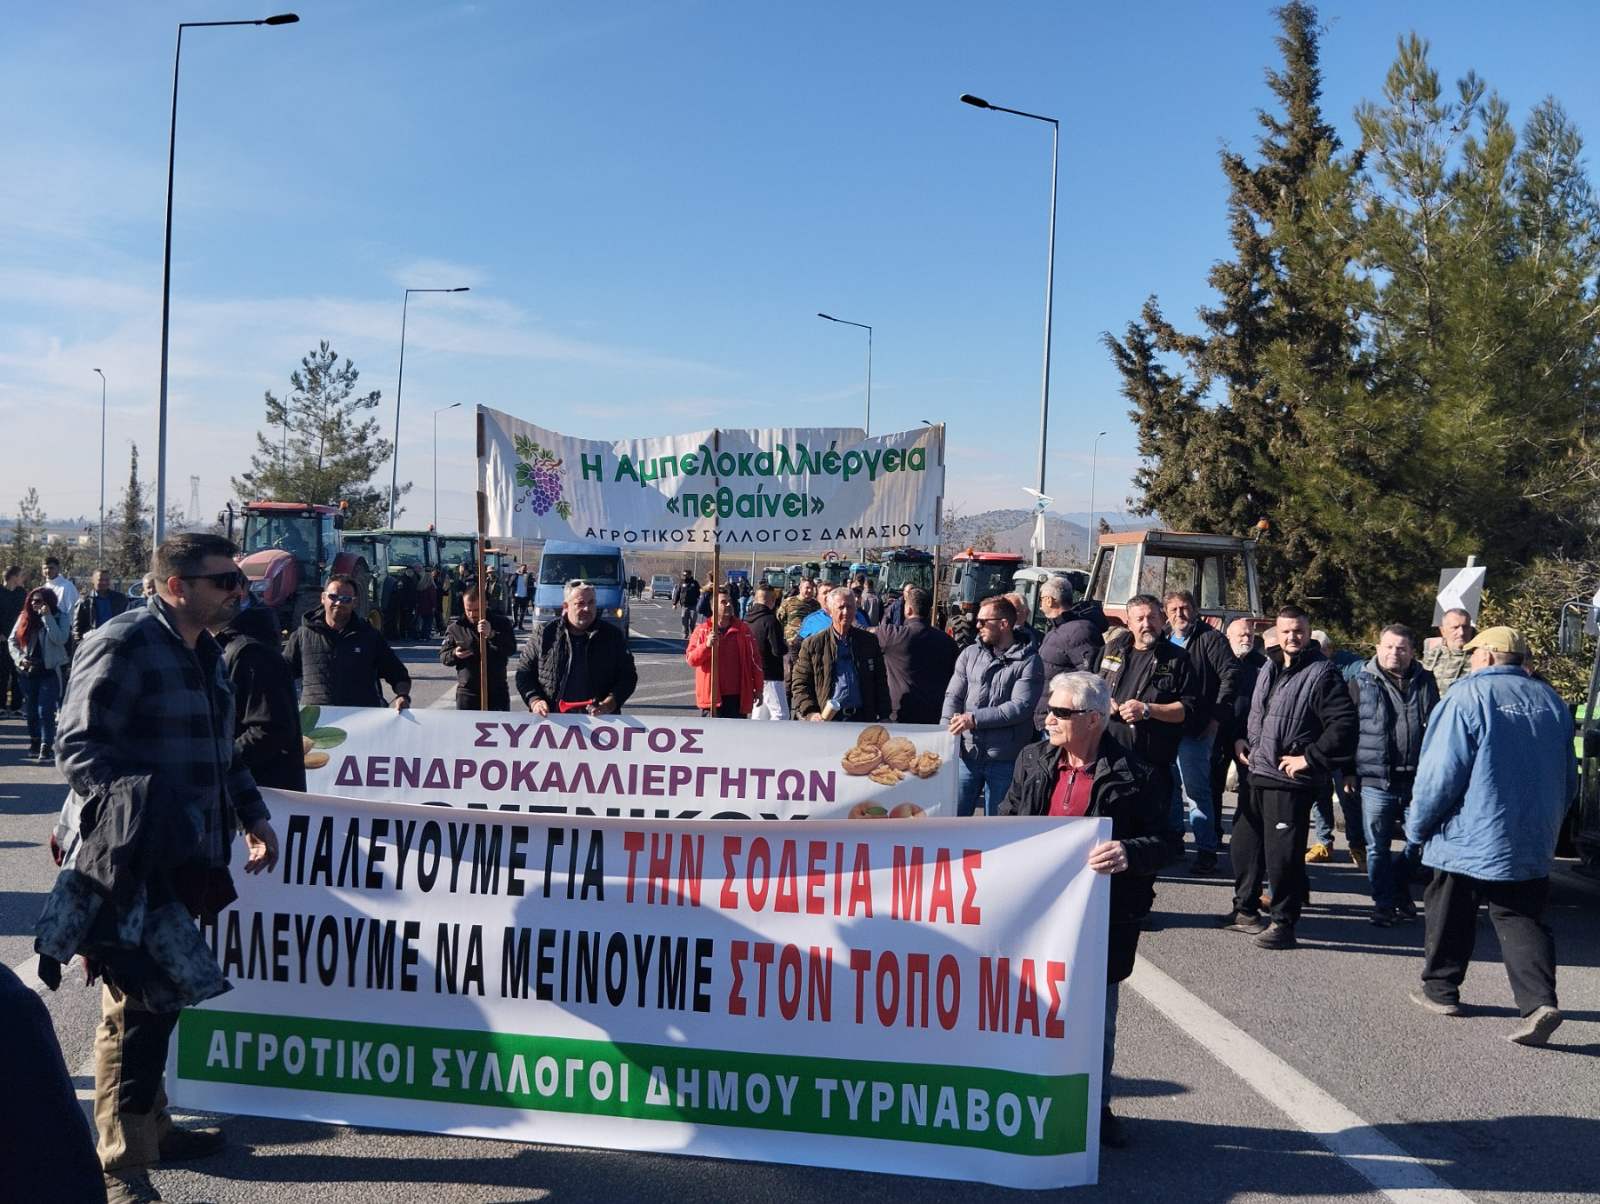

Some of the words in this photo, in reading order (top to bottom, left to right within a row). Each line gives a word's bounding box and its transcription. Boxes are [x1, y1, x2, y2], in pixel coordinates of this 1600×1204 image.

[580, 452, 604, 482] Η
[614, 440, 926, 488] Αμπελοκαλλιέργεια
[585, 526, 696, 543] ΑΓΡΟΤΙΚΟΣ
[703, 528, 812, 543] ΣΥΛΛΟΓΟΣ
[819, 523, 924, 541] ΔΑΜΑΣΙΟΥ
[474, 722, 704, 754] ΣΥΛΛΟΓΟΣ
[334, 755, 836, 803] ΔΕΝΔΡΟΚΑΛΛΙΕΡΓΗΤΩΝ
[283, 814, 529, 898] ΠΑΛΕΥΟΥΜΕ
[544, 827, 605, 901] ΓΙΑ
[624, 831, 704, 907] ΤΗΝ
[719, 835, 873, 919] ΣΟΔΕΙΑ
[891, 845, 982, 926] ΜΑΣ
[435, 922, 485, 996] ΝΑ
[501, 926, 714, 1014] ΜΕΙΝΟΥΜΕ
[728, 940, 833, 1023] ΣΤΟΝ
[850, 949, 960, 1031] ΤΟΠΟ
[978, 956, 1066, 1039] ΜΑΣ
[206, 1029, 415, 1086] ΑΓΡΟΤΙΚΟΙ
[432, 1048, 629, 1103] ΣΥΛΛΟΓΟΙ
[645, 1065, 800, 1116] ΔΗΜΟΥ
[815, 1078, 1053, 1140] ΤΥΡΝΑΒΟΥ
